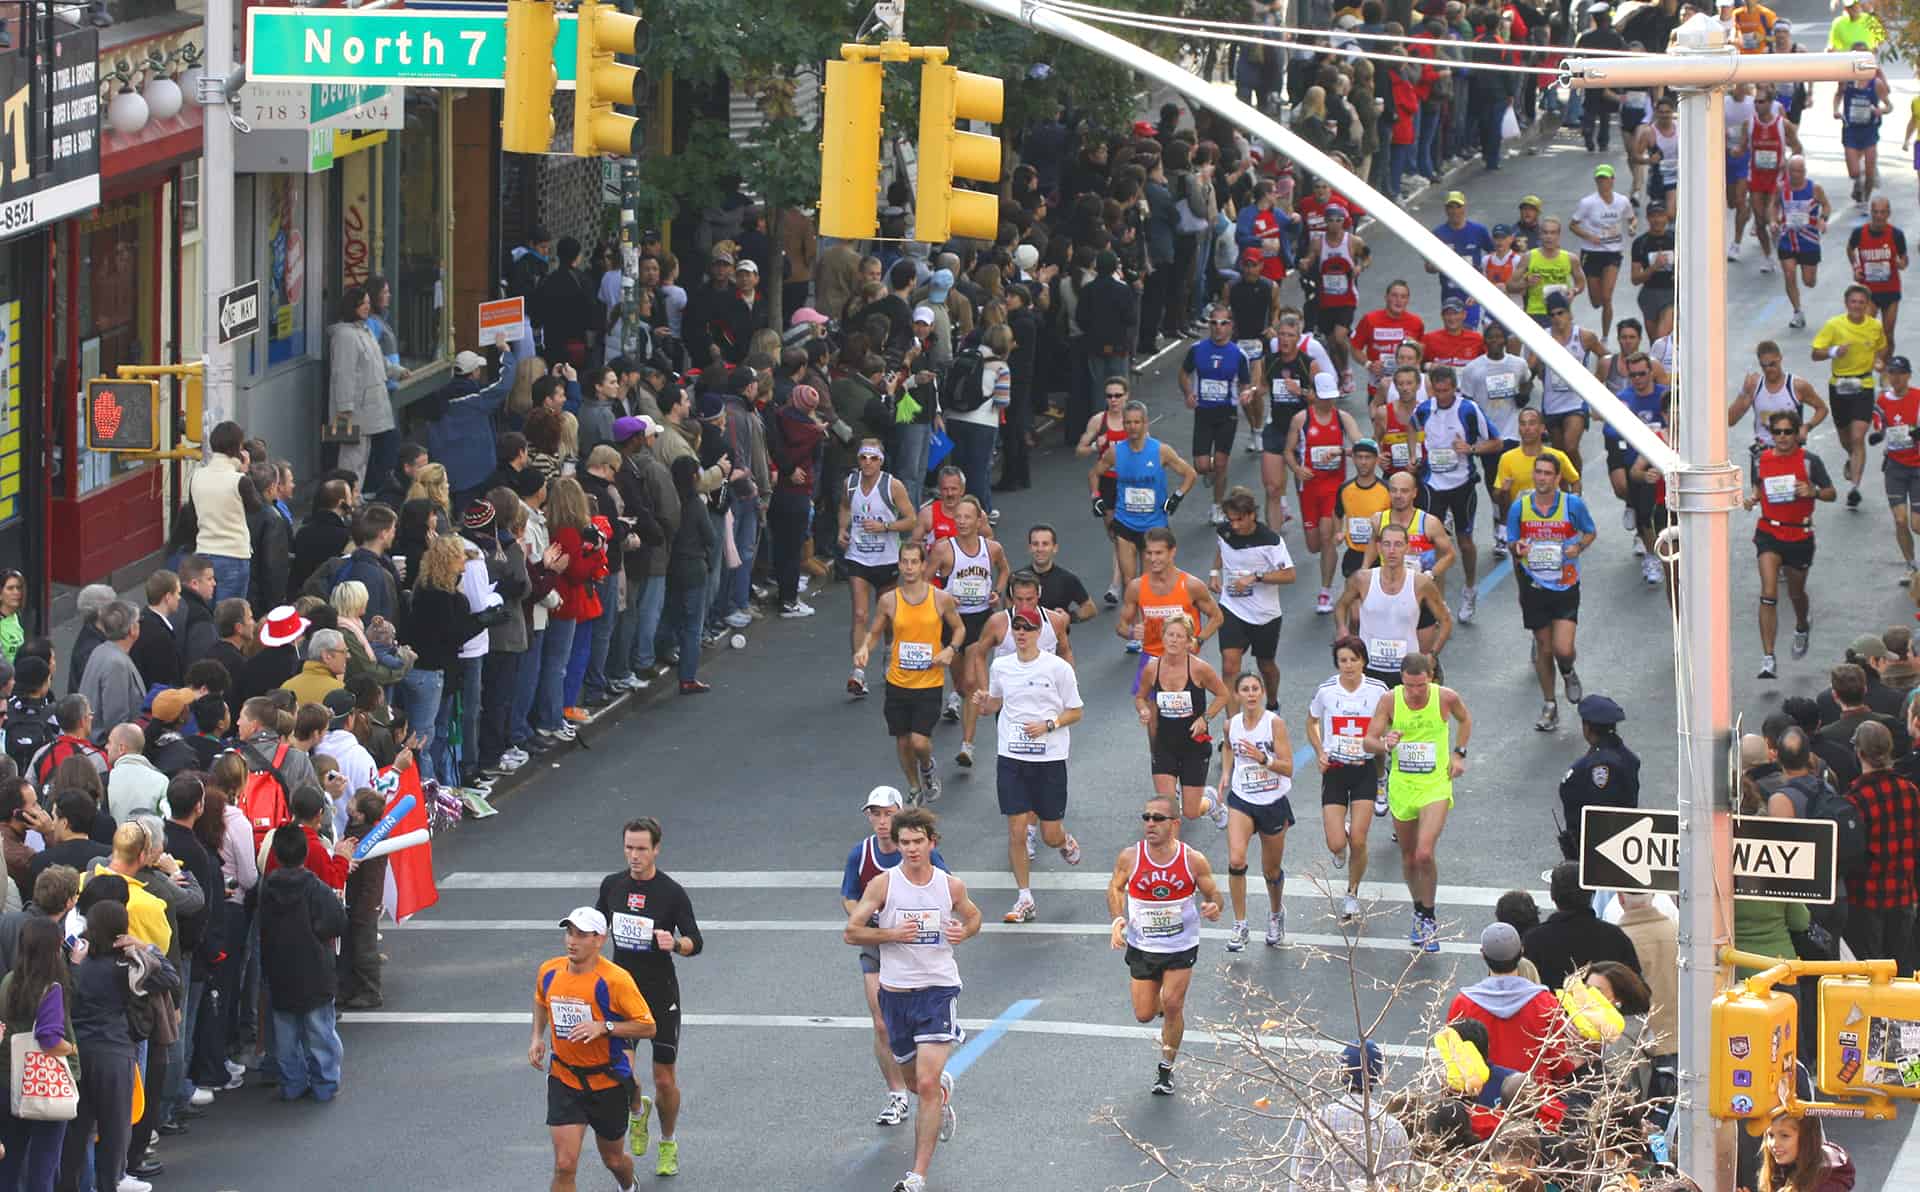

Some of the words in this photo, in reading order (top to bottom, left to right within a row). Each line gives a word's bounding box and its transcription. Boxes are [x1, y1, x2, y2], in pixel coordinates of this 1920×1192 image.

[304, 28, 444, 65] North
[460, 30, 487, 66] 7
[256, 105, 288, 121] 718
[240, 297, 255, 321] WAY
[361, 815, 397, 853] GARMIN
[1732, 843, 1800, 874] WAY
[1137, 871, 1184, 891] ITALIA
[904, 912, 920, 920] ING
[622, 925, 642, 938] 2043
[23, 1082, 73, 1096] WNYC
